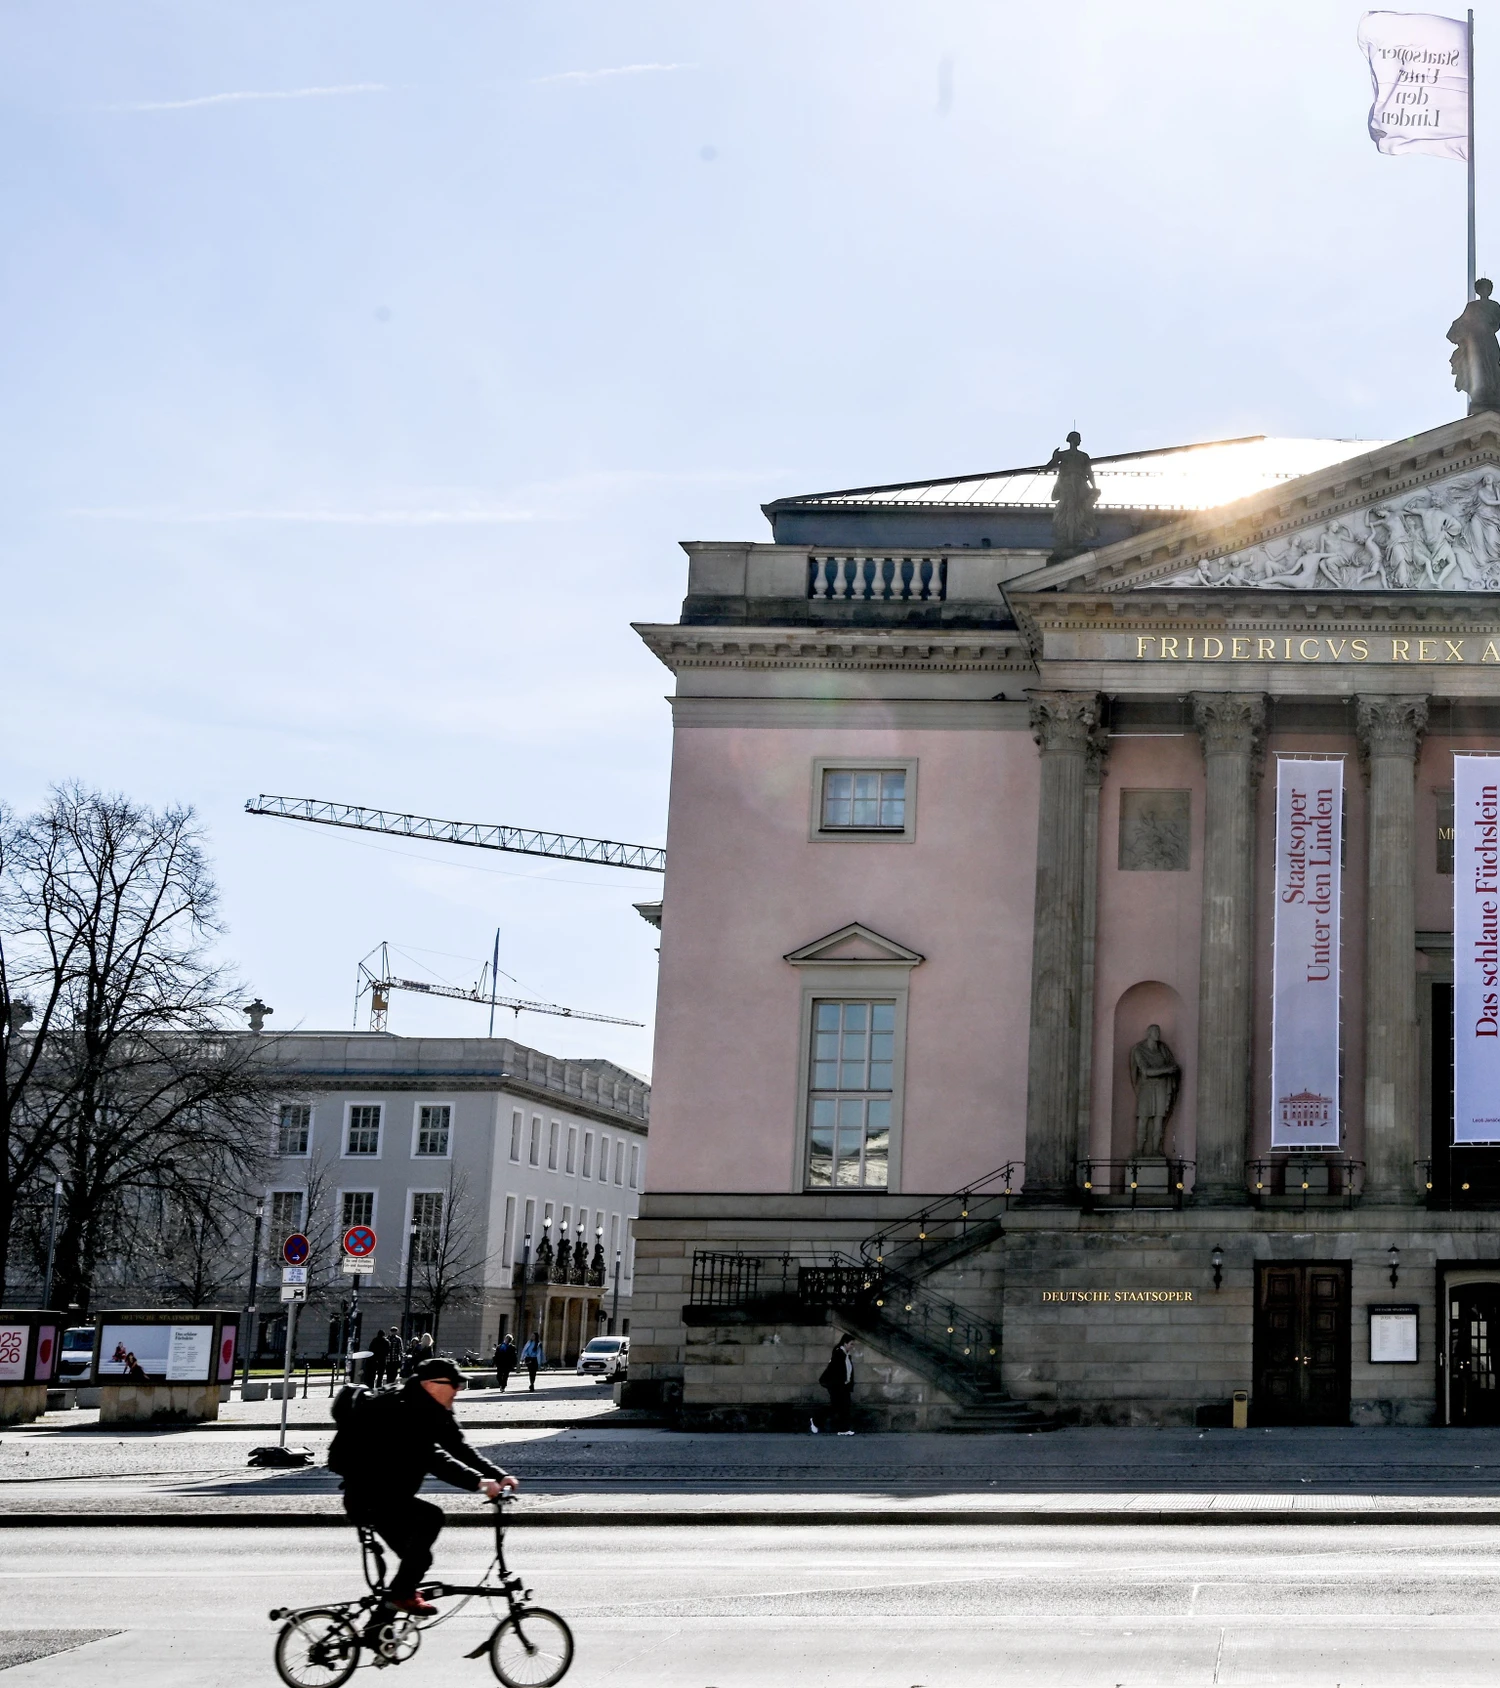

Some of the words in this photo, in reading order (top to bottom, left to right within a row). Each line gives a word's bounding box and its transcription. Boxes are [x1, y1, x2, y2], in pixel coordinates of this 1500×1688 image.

[1136, 636, 1368, 660] FRIDERICVS
[1392, 639, 1464, 661] REX
[1281, 788, 1312, 904] Staatsoper
[1309, 788, 1333, 867] Linden
[1474, 785, 1498, 894] Füchslein
[1308, 872, 1331, 915] den
[1307, 920, 1331, 983] Unter
[1474, 901, 1498, 986] schlaue
[1476, 988, 1498, 1038] Das
[1042, 1291, 1111, 1302] DEUTSCHE
[1114, 1291, 1193, 1302] STAATSOPER
[0, 1332, 22, 1348] 25
